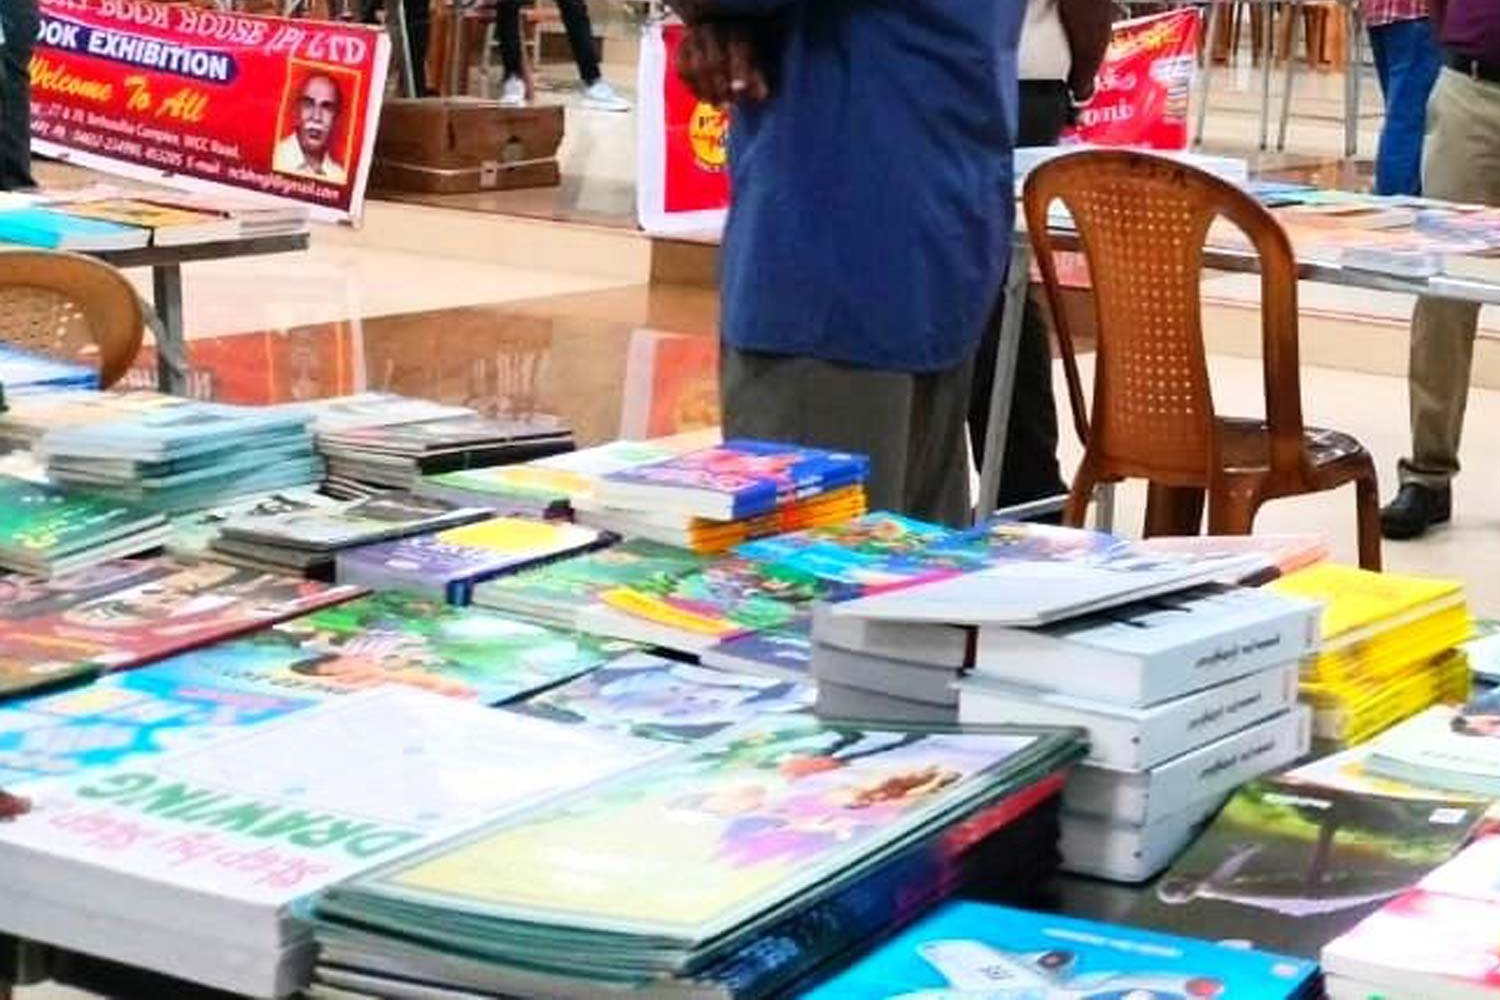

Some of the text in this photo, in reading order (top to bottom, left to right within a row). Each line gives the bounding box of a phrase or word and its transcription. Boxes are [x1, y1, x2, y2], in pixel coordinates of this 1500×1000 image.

[87, 29, 228, 81] EXHIBITION
[176, 8, 269, 46] HOUSE
[307, 32, 367, 65] LTD
[28, 54, 113, 102] Welcome
[124, 74, 150, 111] To
[154, 86, 209, 123] All
[76, 772, 423, 860] DRAWING
